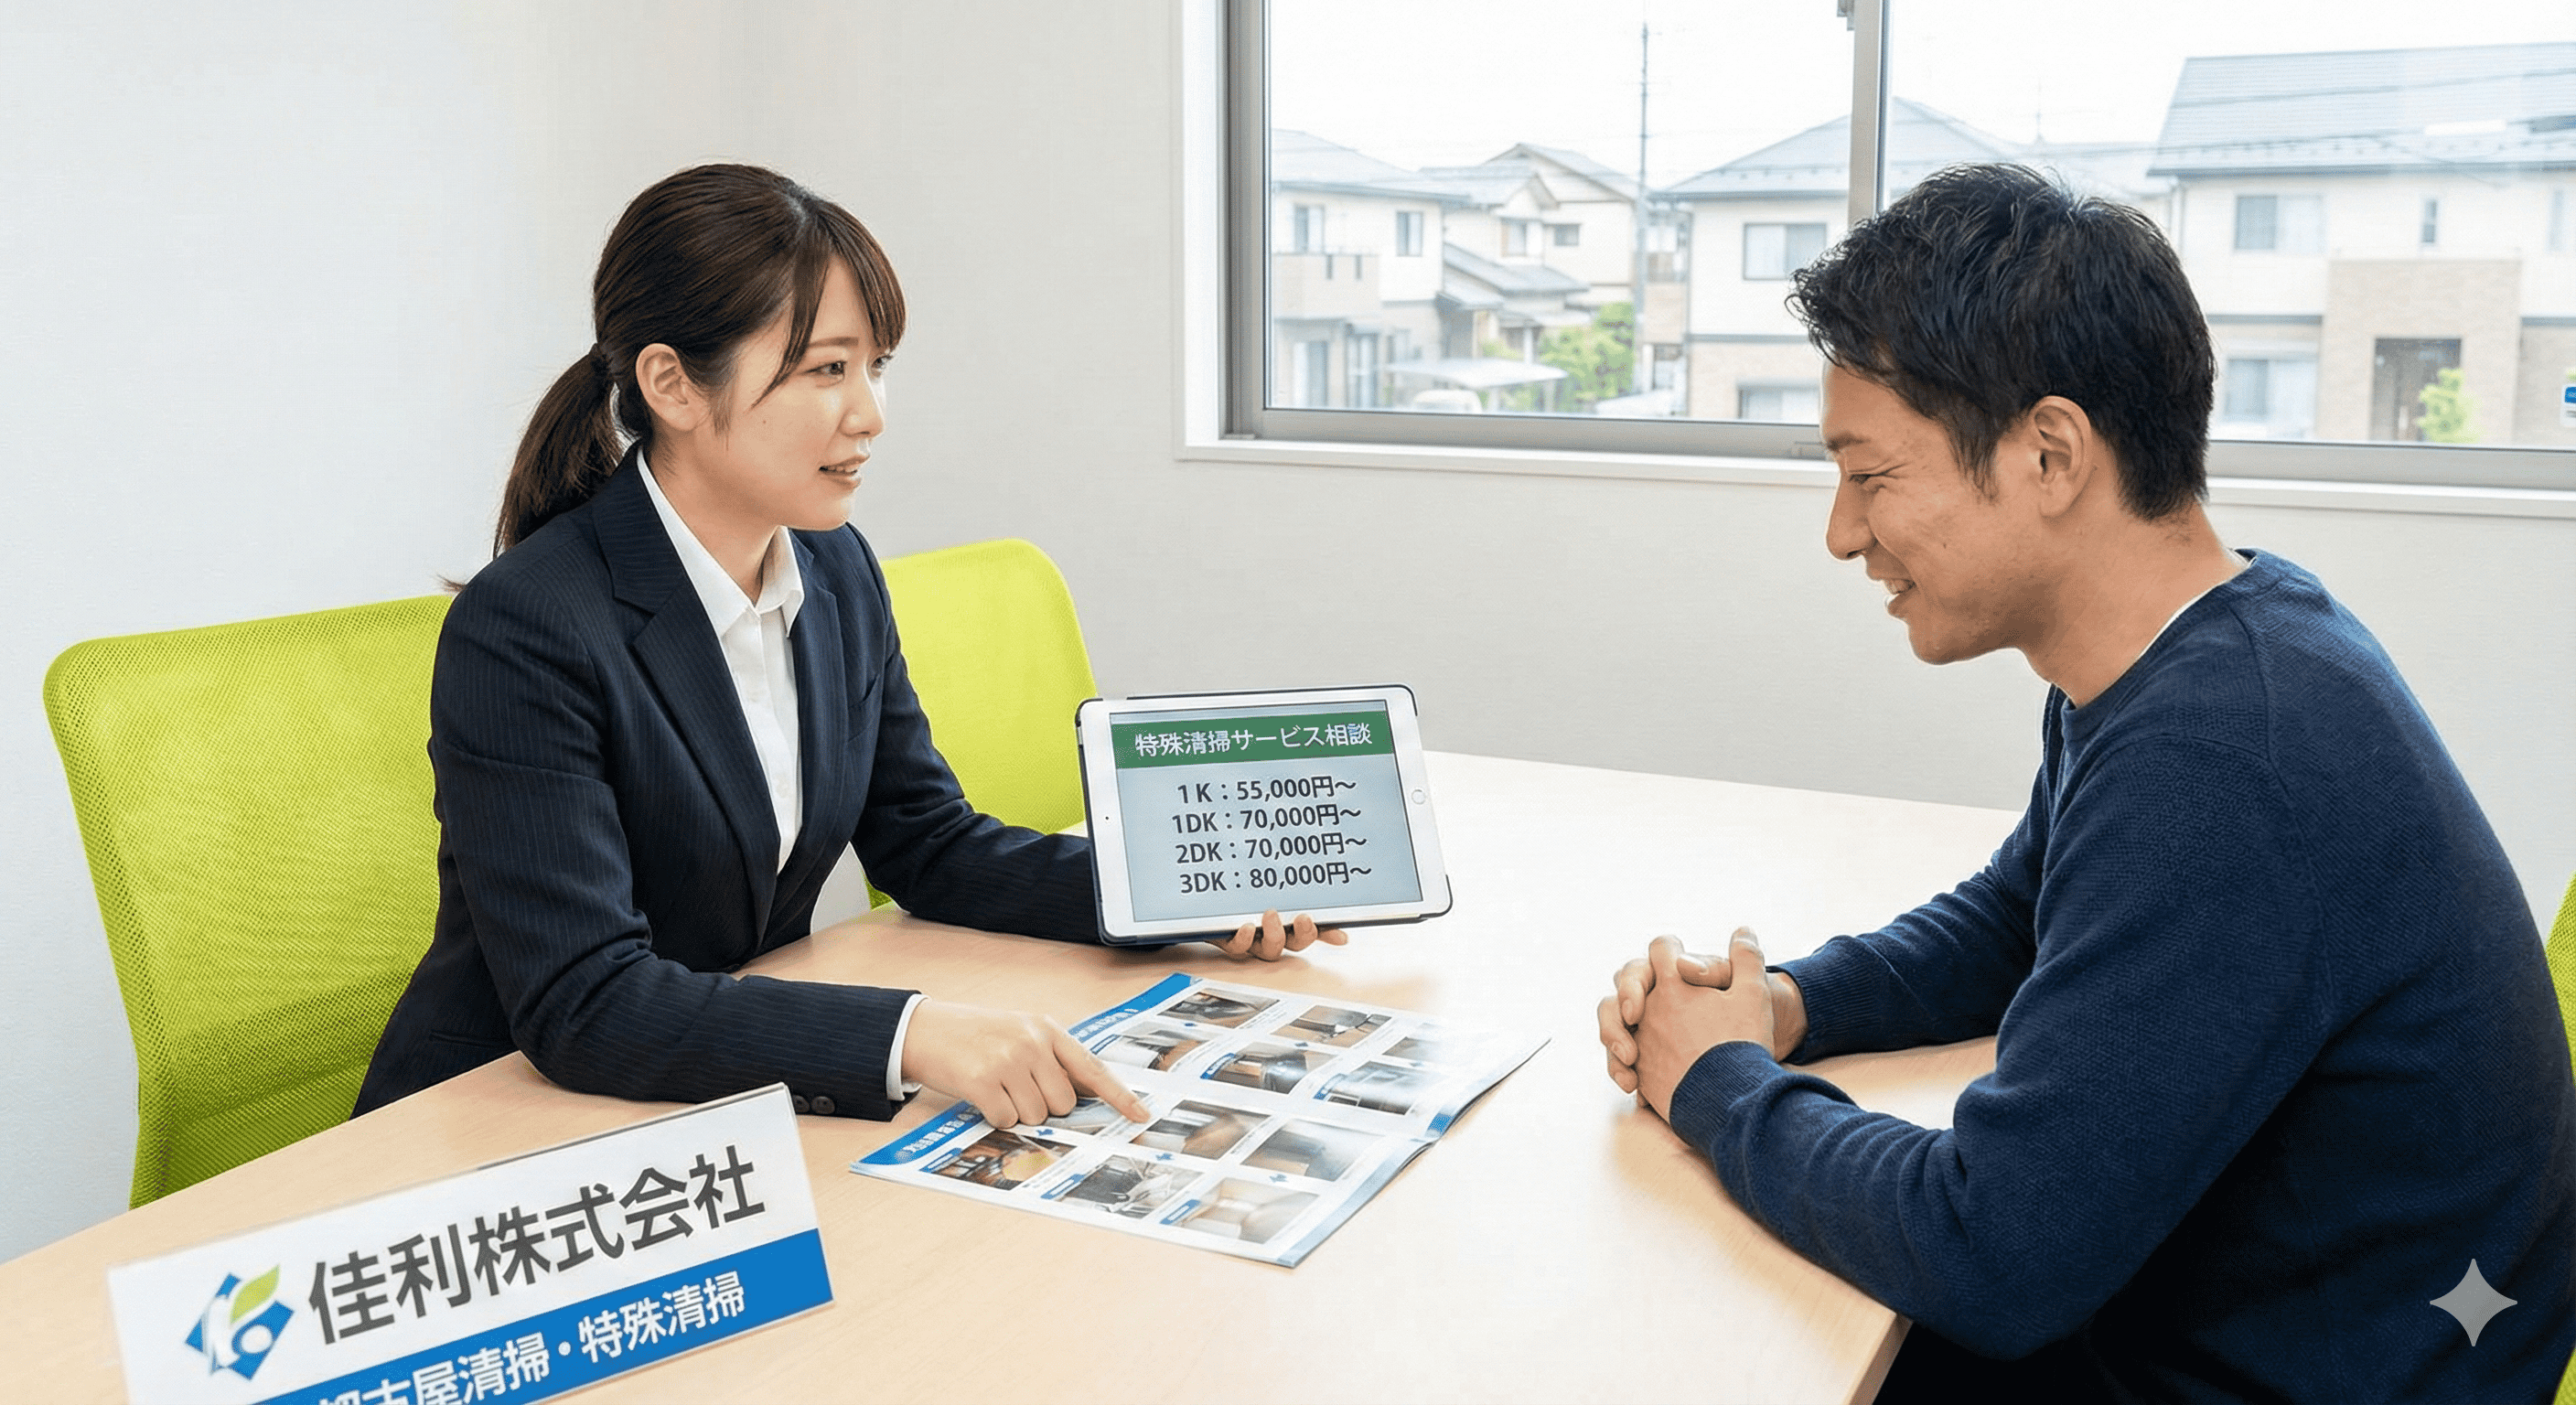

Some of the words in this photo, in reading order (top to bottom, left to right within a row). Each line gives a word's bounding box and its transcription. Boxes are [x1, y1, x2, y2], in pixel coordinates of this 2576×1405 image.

[1135, 723, 1372, 756] 特殊清掃サービス相談
[308, 1145, 766, 1345] 佳利株式会社
